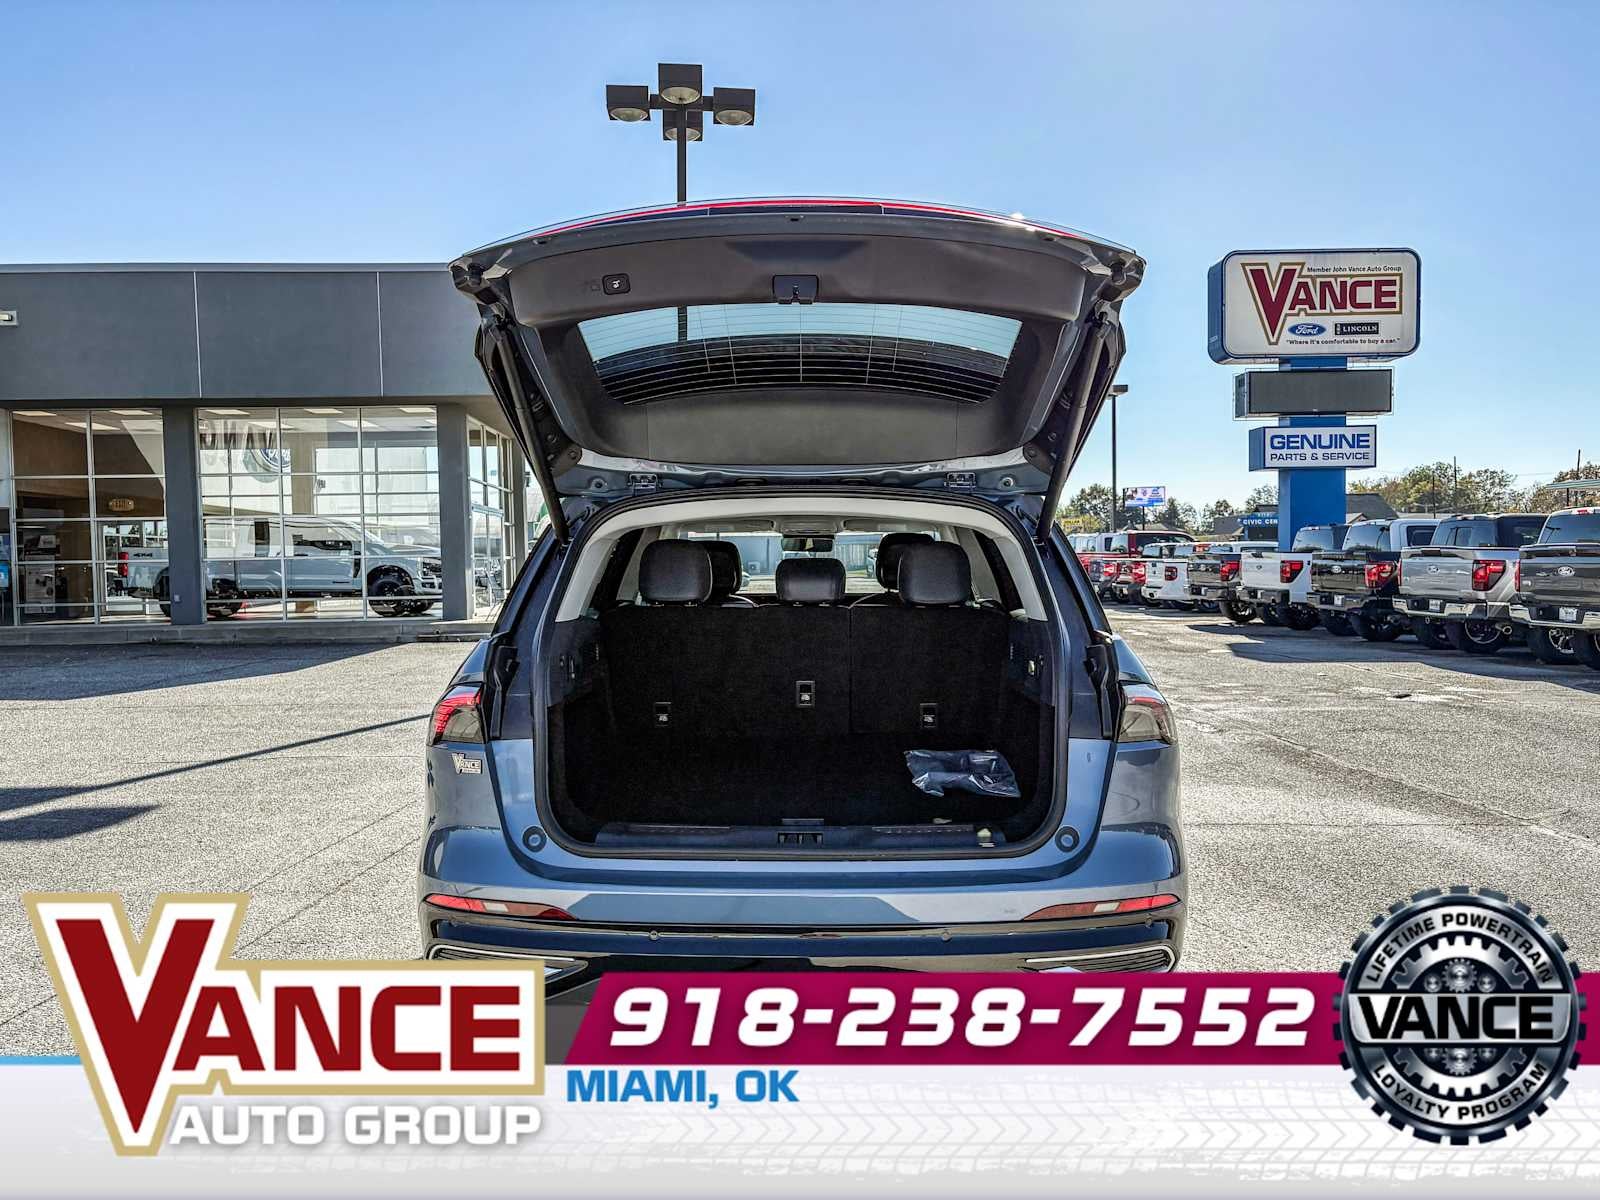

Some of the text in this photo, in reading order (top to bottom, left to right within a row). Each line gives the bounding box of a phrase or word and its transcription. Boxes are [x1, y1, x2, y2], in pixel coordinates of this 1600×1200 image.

[1248, 268, 1398, 338] VANCE
[1342, 323, 1378, 333] LINCOLN
[1270, 433, 1370, 450] GENUINE
[1270, 452, 1370, 461] PARTS & SERVICE
